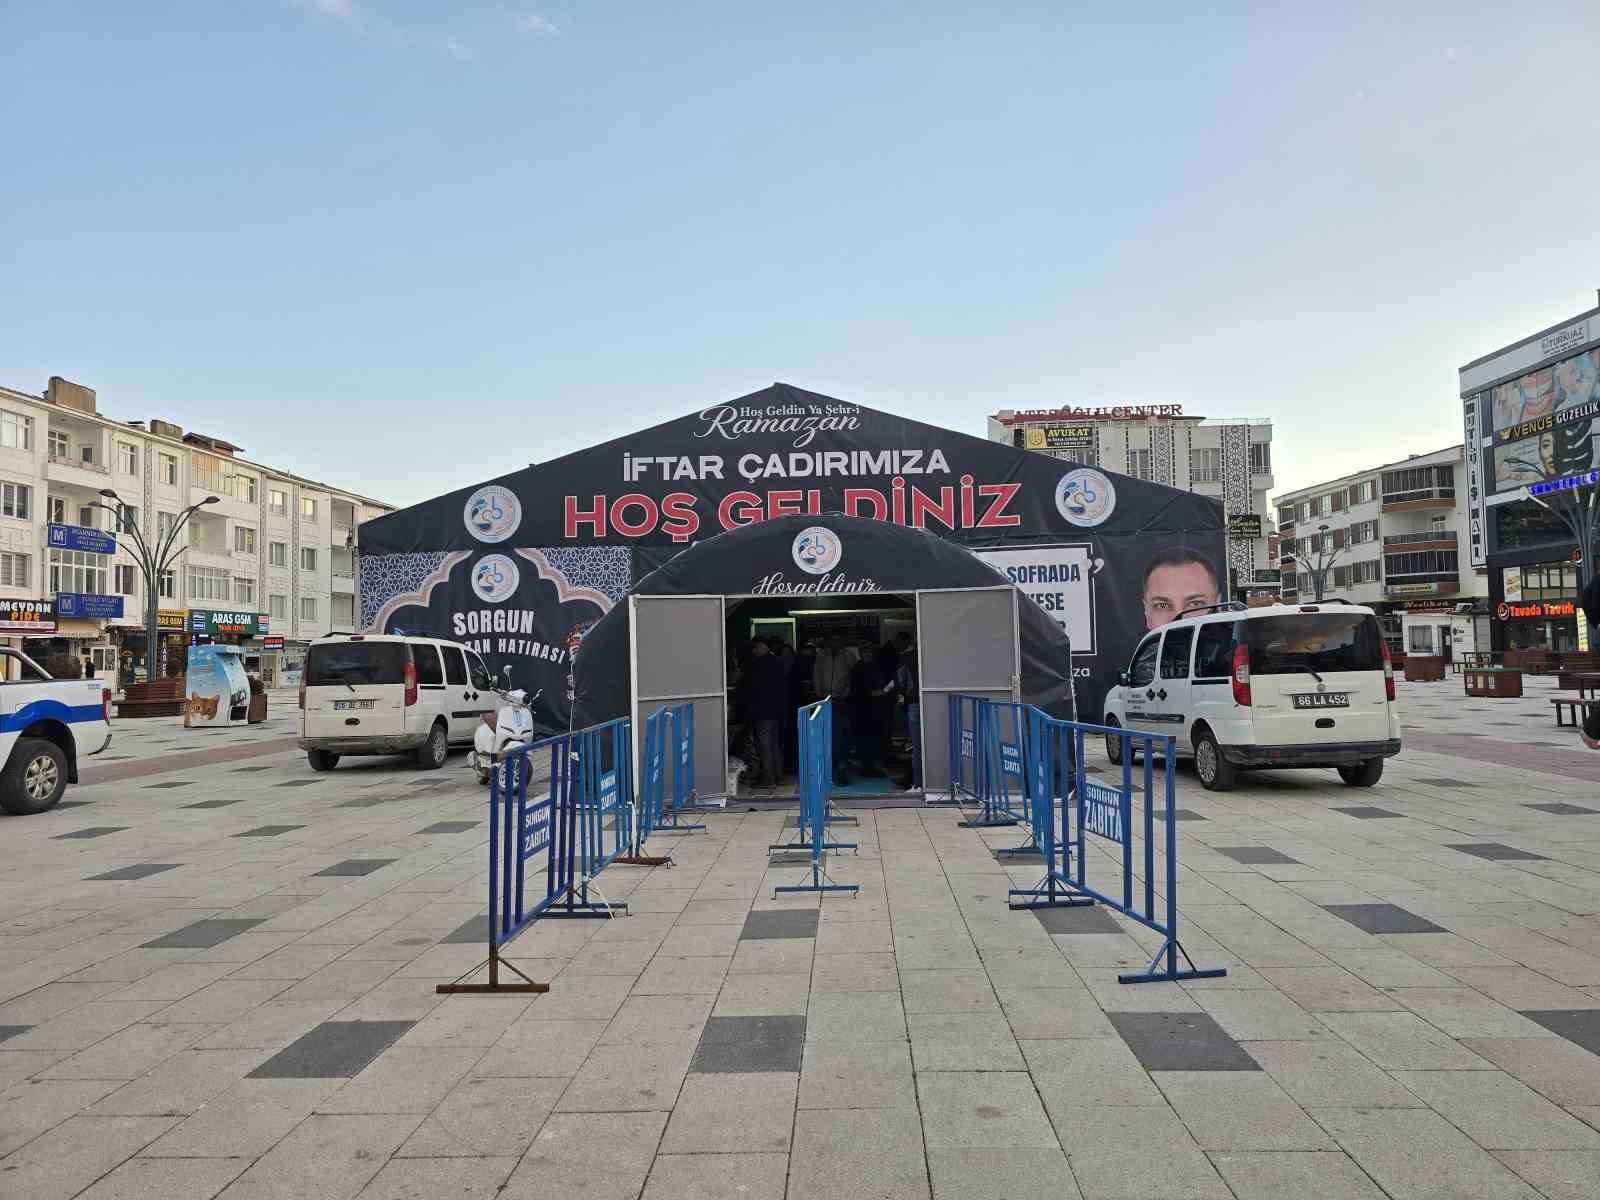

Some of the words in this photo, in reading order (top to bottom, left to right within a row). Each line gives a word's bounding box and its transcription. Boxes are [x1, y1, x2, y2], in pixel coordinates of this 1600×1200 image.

[740, 407, 763, 419] Hoş
[766, 404, 806, 417] Geldin
[809, 404, 823, 415] Ya
[825, 403, 860, 417] Şehr-i
[1112, 404, 1184, 417] CENTER
[693, 405, 862, 448] Ramazan
[1047, 428, 1088, 437] AVUKAT
[622, 451, 725, 482] İFTAR
[737, 449, 951, 484] ÇADIRIMIZA
[563, 493, 700, 543] HOŞ
[1006, 564, 1081, 584] SOFRADA
[453, 609, 535, 636] SORGUN
[498, 638, 566, 664] HATIRASI
[1298, 695, 1312, 706] 66
[1313, 695, 1327, 705] LA
[1328, 694, 1346, 705] 452
[1084, 799, 1122, 842] ZABITA
